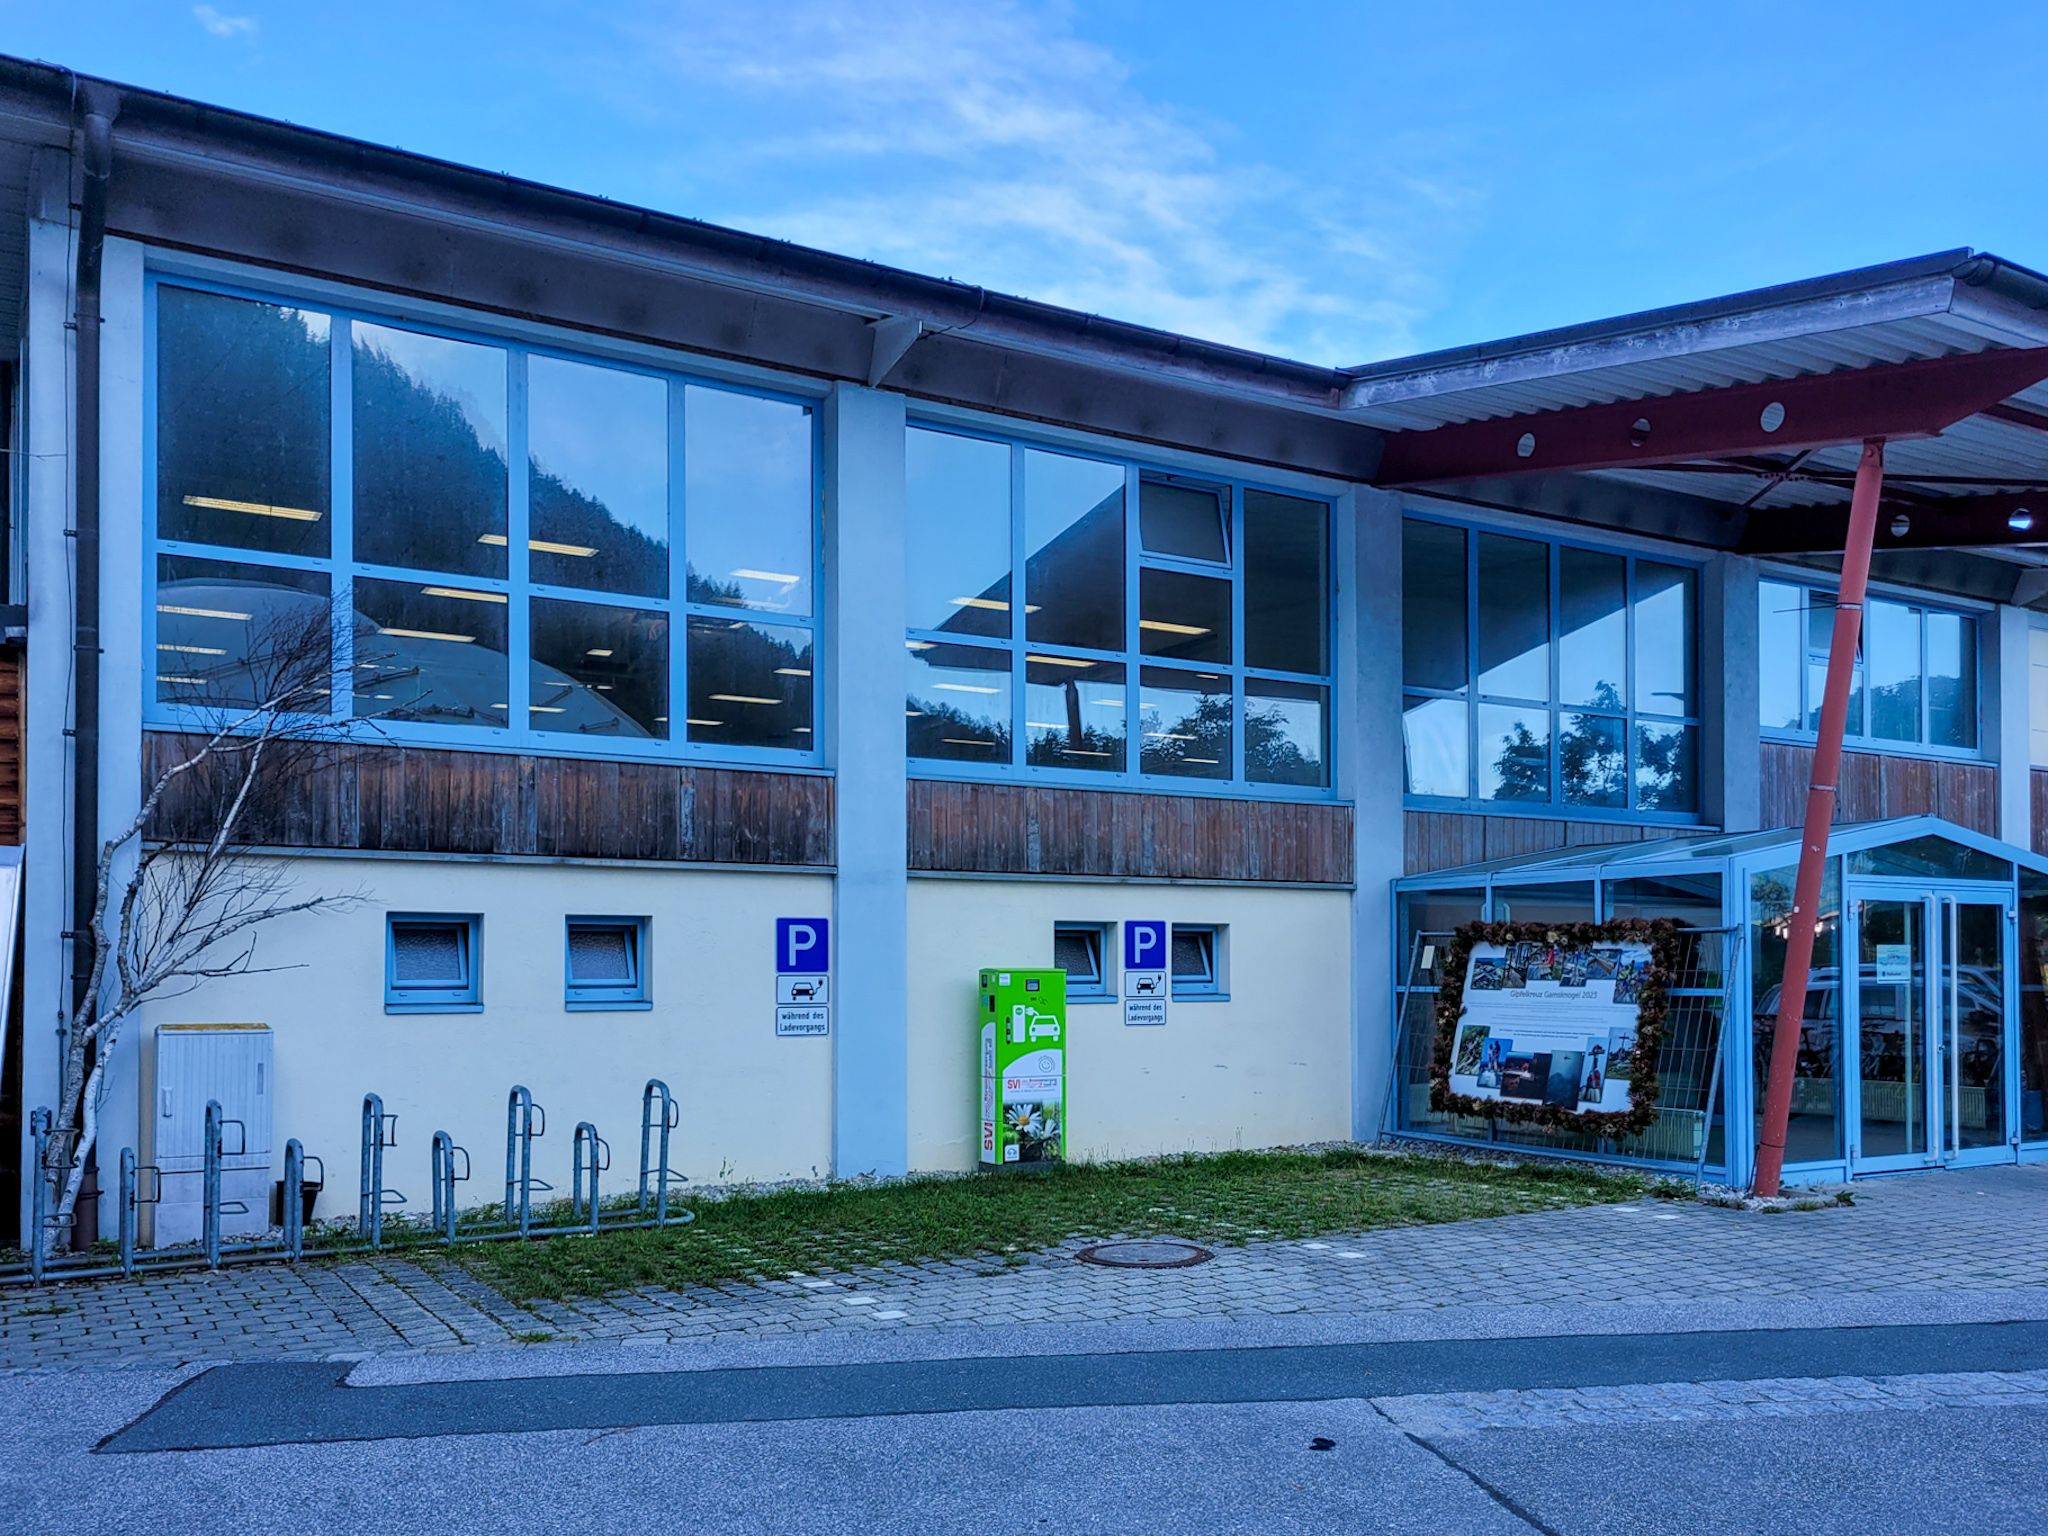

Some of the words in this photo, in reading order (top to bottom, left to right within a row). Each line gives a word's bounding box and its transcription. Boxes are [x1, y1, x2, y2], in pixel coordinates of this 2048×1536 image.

[788, 924, 817, 967] P
[1134, 926, 1157, 964] P
[1582, 991, 1598, 999] 2023
[1129, 1003, 1151, 1011] während
[1153, 1003, 1162, 1011] des
[781, 1011, 810, 1020] während
[812, 1011, 825, 1020] des
[1127, 1014, 1163, 1023] Ladevorgangs
[779, 1023, 826, 1033] Ladevorgangs
[1007, 1079, 1021, 1089] SVI
[984, 1122, 993, 1151] SVI
